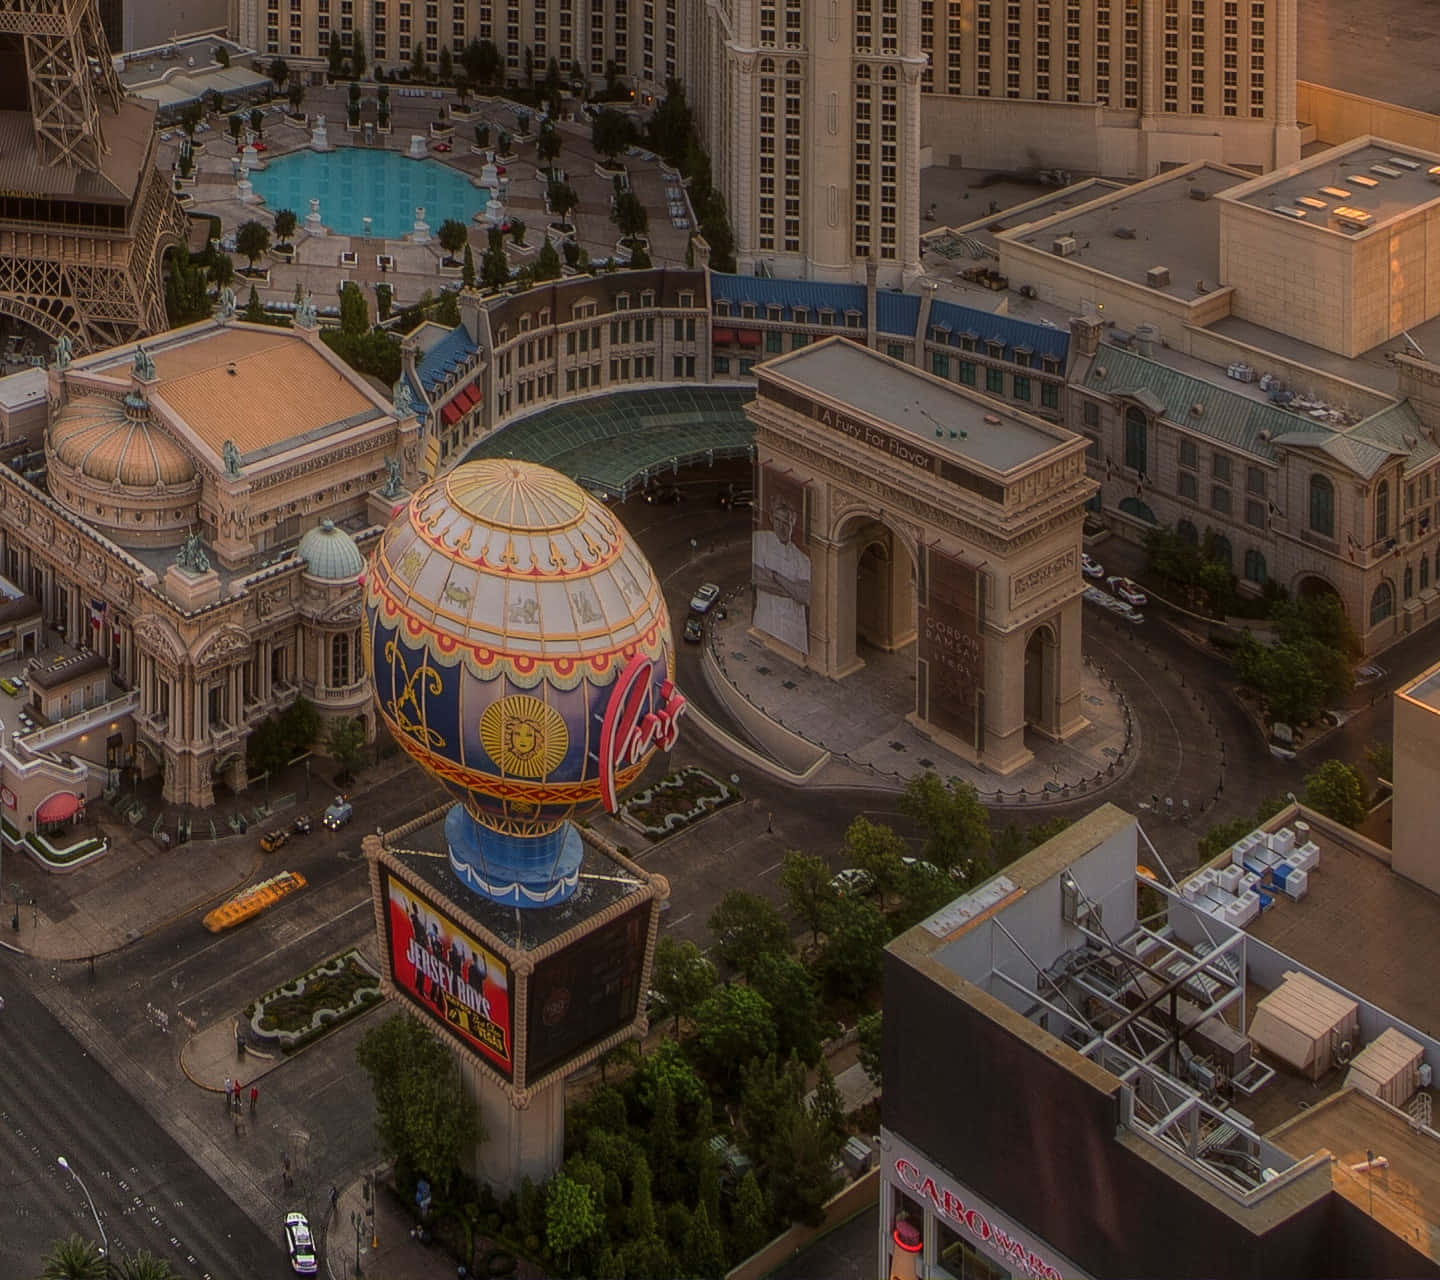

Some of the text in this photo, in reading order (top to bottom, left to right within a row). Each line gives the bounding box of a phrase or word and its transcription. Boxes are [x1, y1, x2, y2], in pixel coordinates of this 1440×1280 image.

[822, 410, 929, 468] A Fury For Flavor
[599, 652, 686, 814] Paris
[406, 936, 456, 996] JERSEY
[457, 976, 492, 1024] BOYS
[895, 1159, 1063, 1280] CABO WABO
